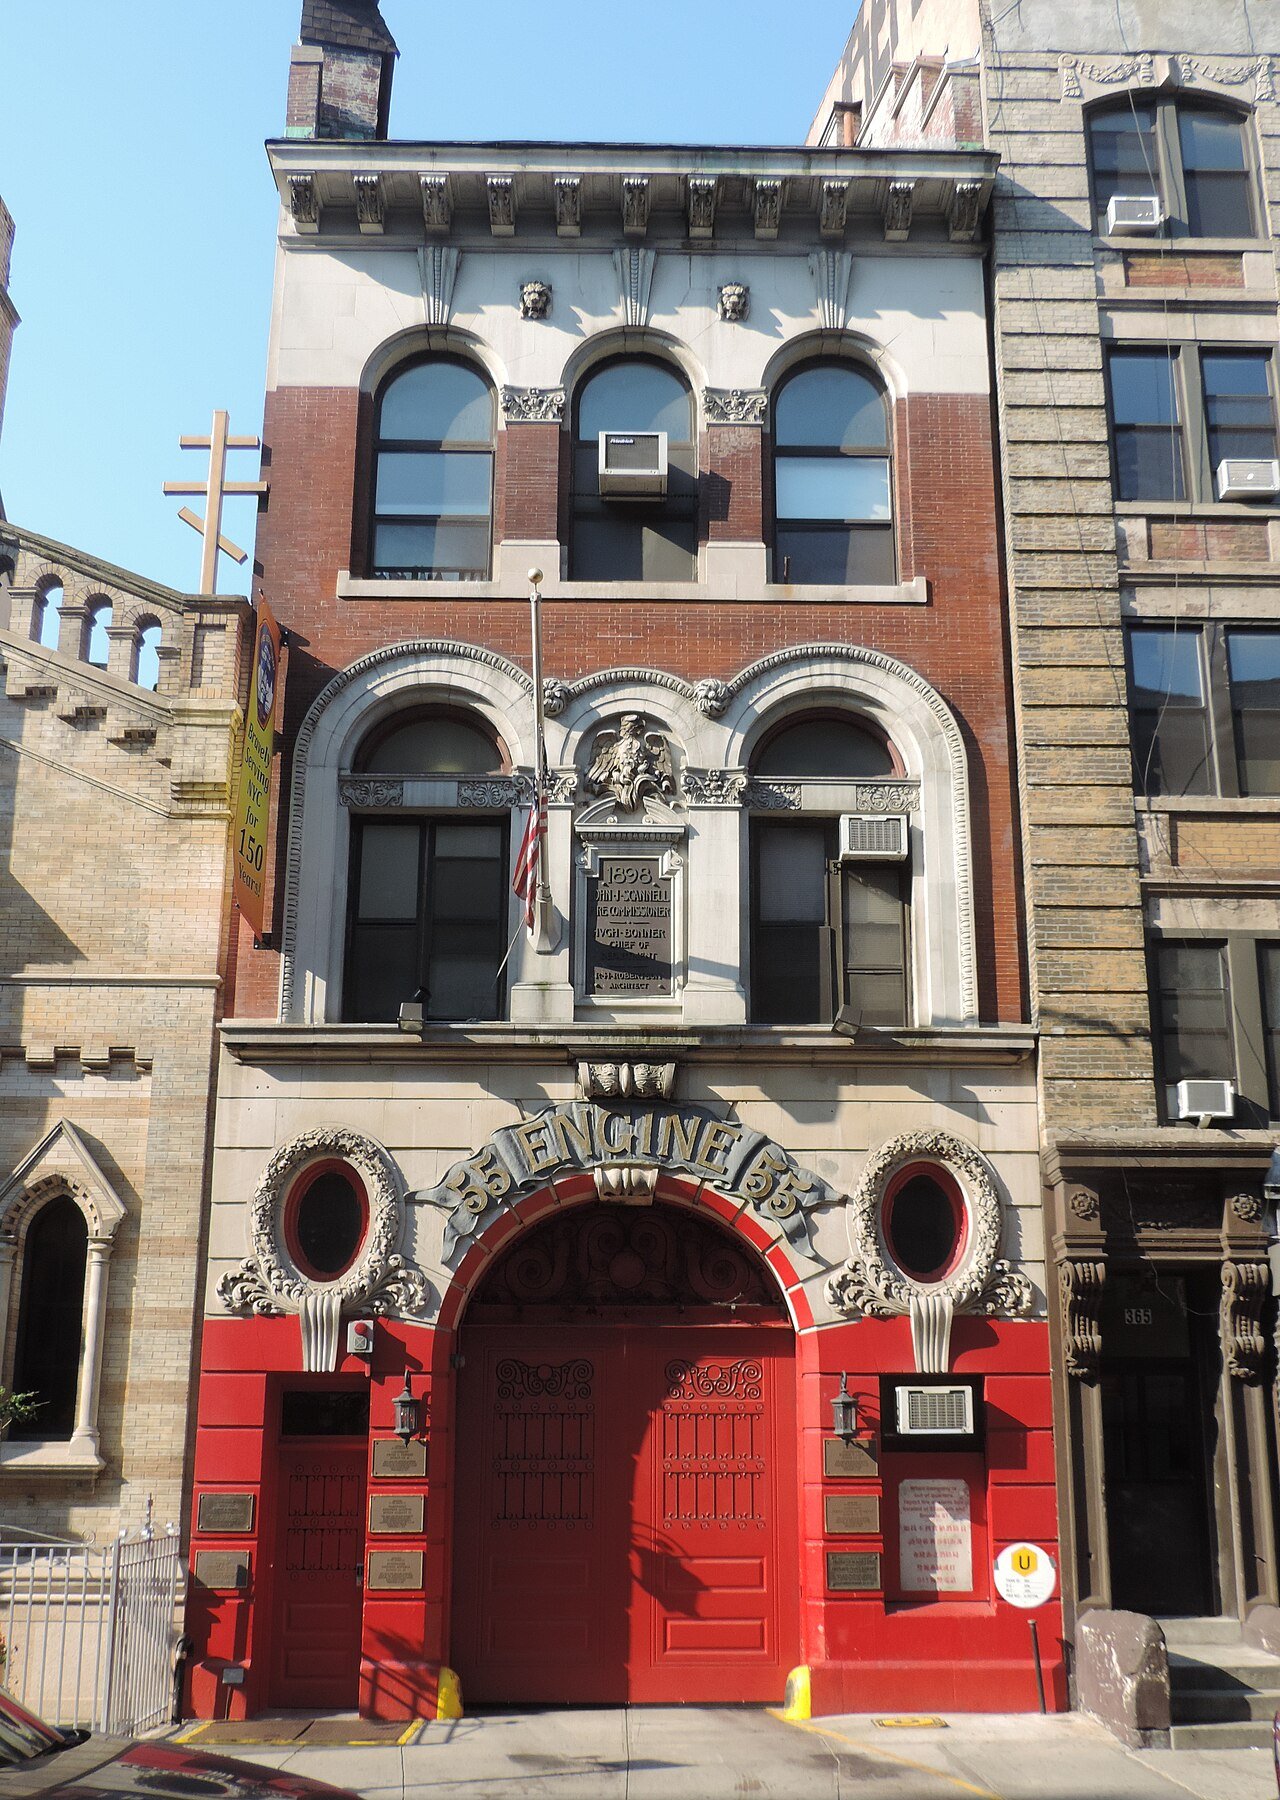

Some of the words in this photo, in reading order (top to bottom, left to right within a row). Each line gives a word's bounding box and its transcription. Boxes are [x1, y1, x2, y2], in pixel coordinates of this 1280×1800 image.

[248, 722, 270, 768] Bravely
[245, 746, 270, 794] Serving
[247, 779, 263, 807] NYC
[245, 805, 259, 828] for
[239, 829, 263, 872] 150
[239, 862, 262, 897] Years!
[608, 867, 653, 884] 1898
[594, 889, 613, 902] OHN
[610, 906, 671, 918] COMMISSIONER
[638, 941, 650, 950] OF
[446, 1150, 512, 1214] 55
[516, 1106, 743, 1174] ENGINE
[745, 1150, 817, 1218] 55
[1126, 1309, 1150, 1324] 365
[1019, 1555, 1030, 1570] U
